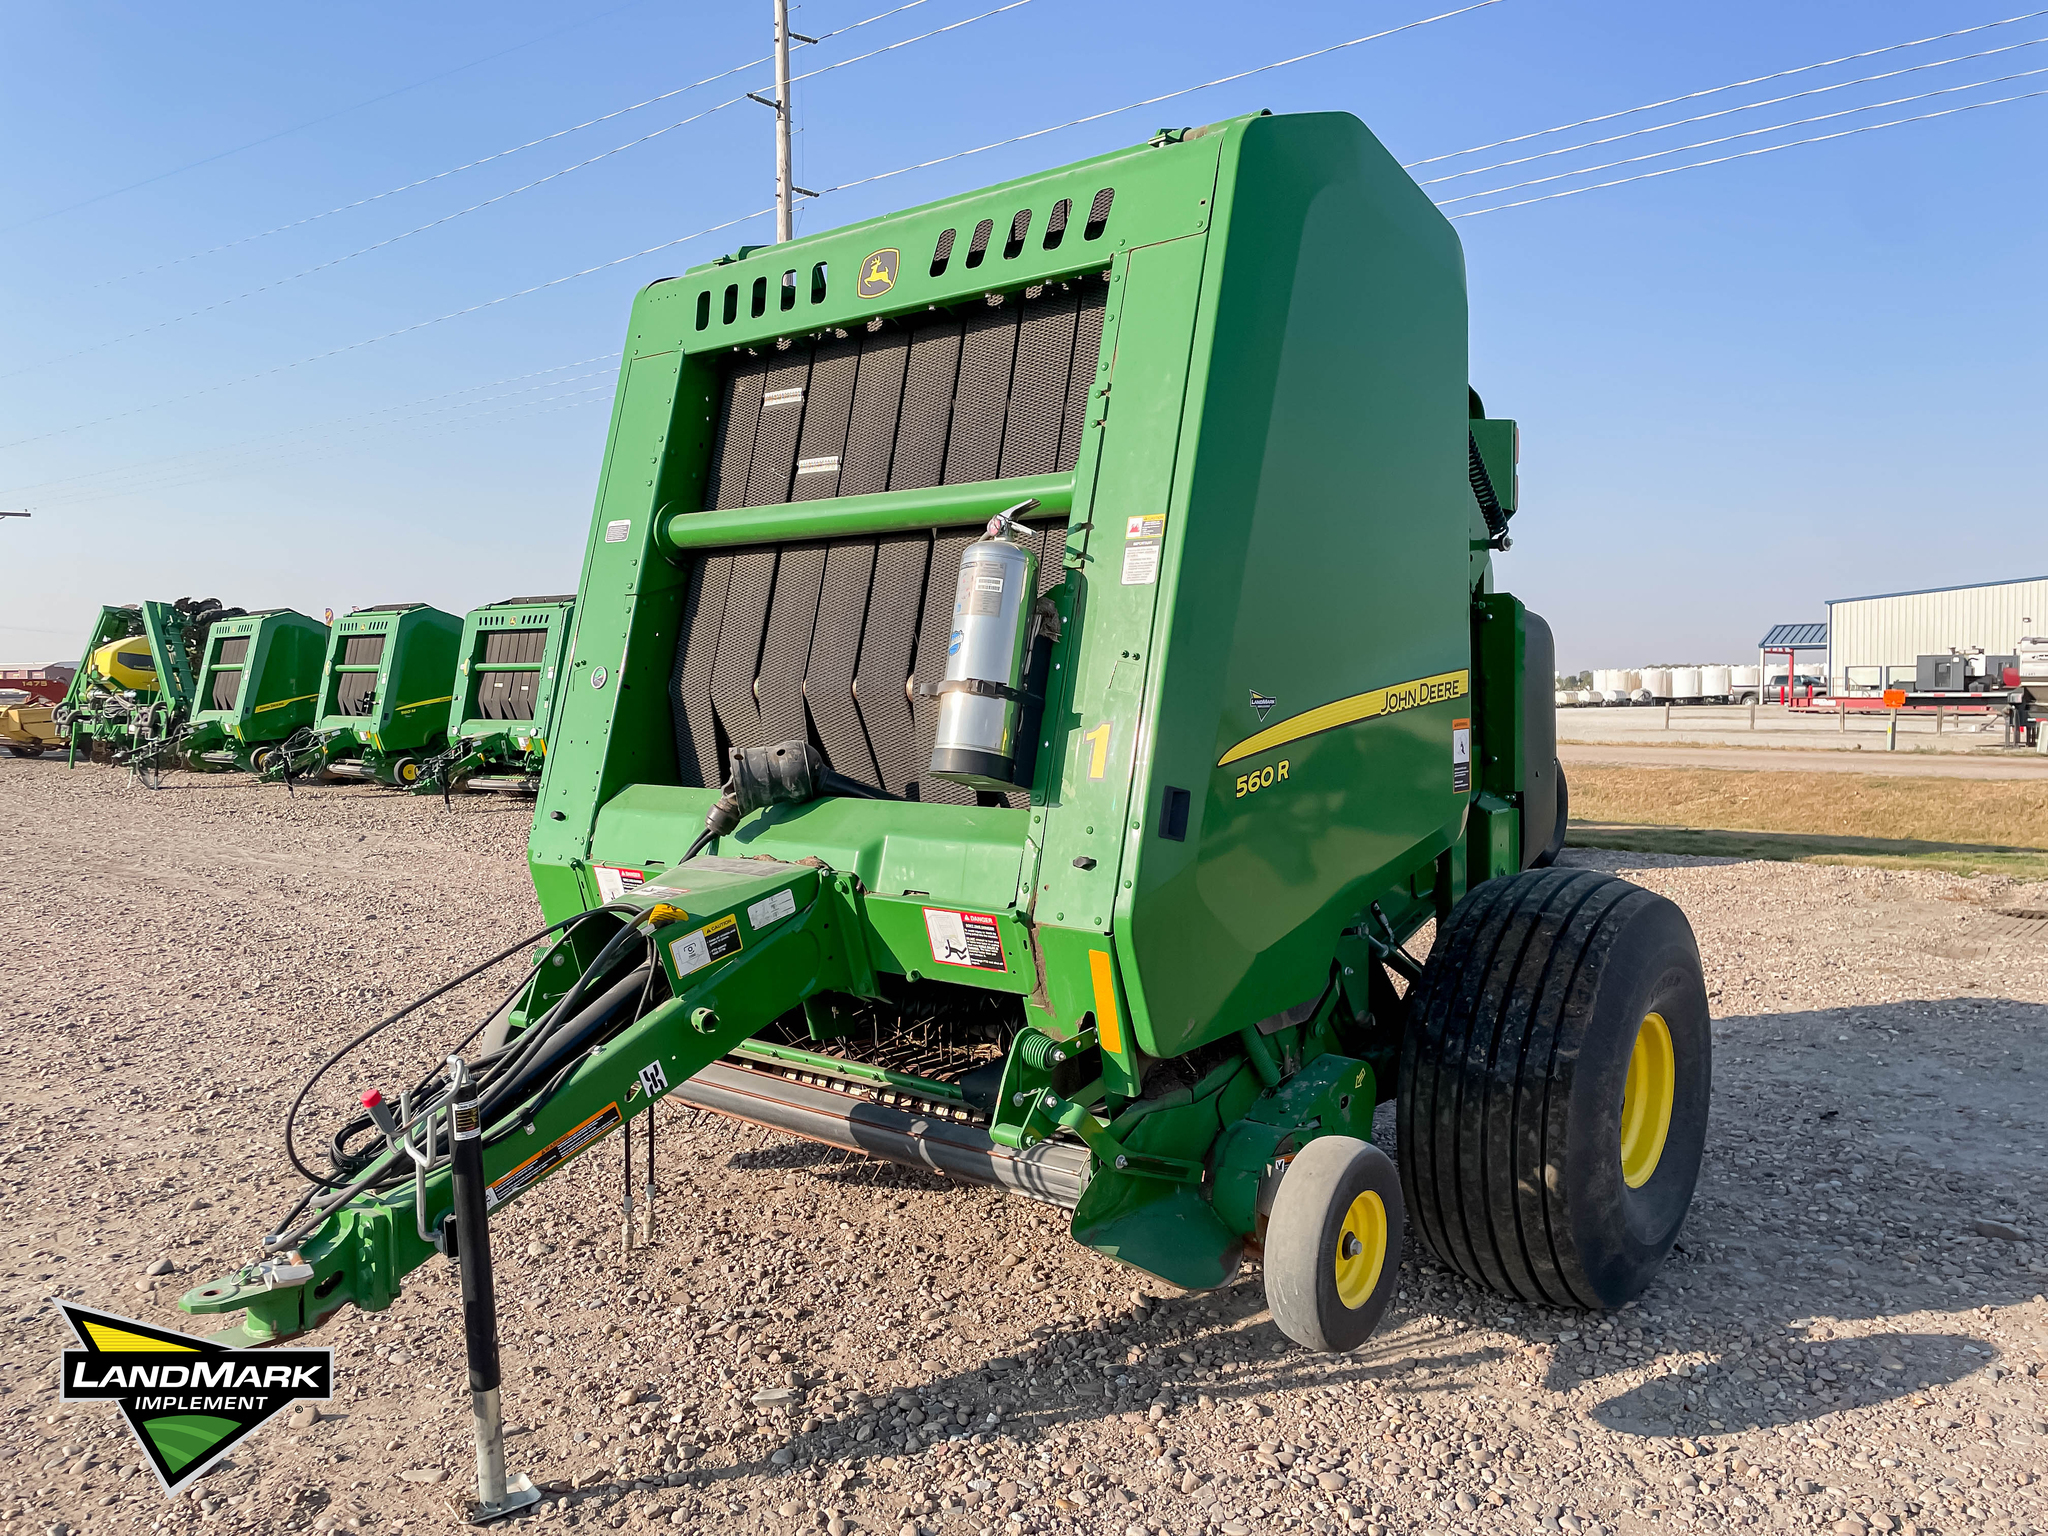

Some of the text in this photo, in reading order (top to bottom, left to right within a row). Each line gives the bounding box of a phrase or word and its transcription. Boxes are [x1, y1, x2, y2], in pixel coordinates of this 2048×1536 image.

[1381, 680, 1460, 713] JOHN DEERE
[1085, 723, 1112, 779] 1
[1236, 759, 1290, 799] 560 R
[711, 918, 732, 932] CAUTION
[970, 915, 993, 924] DANGER
